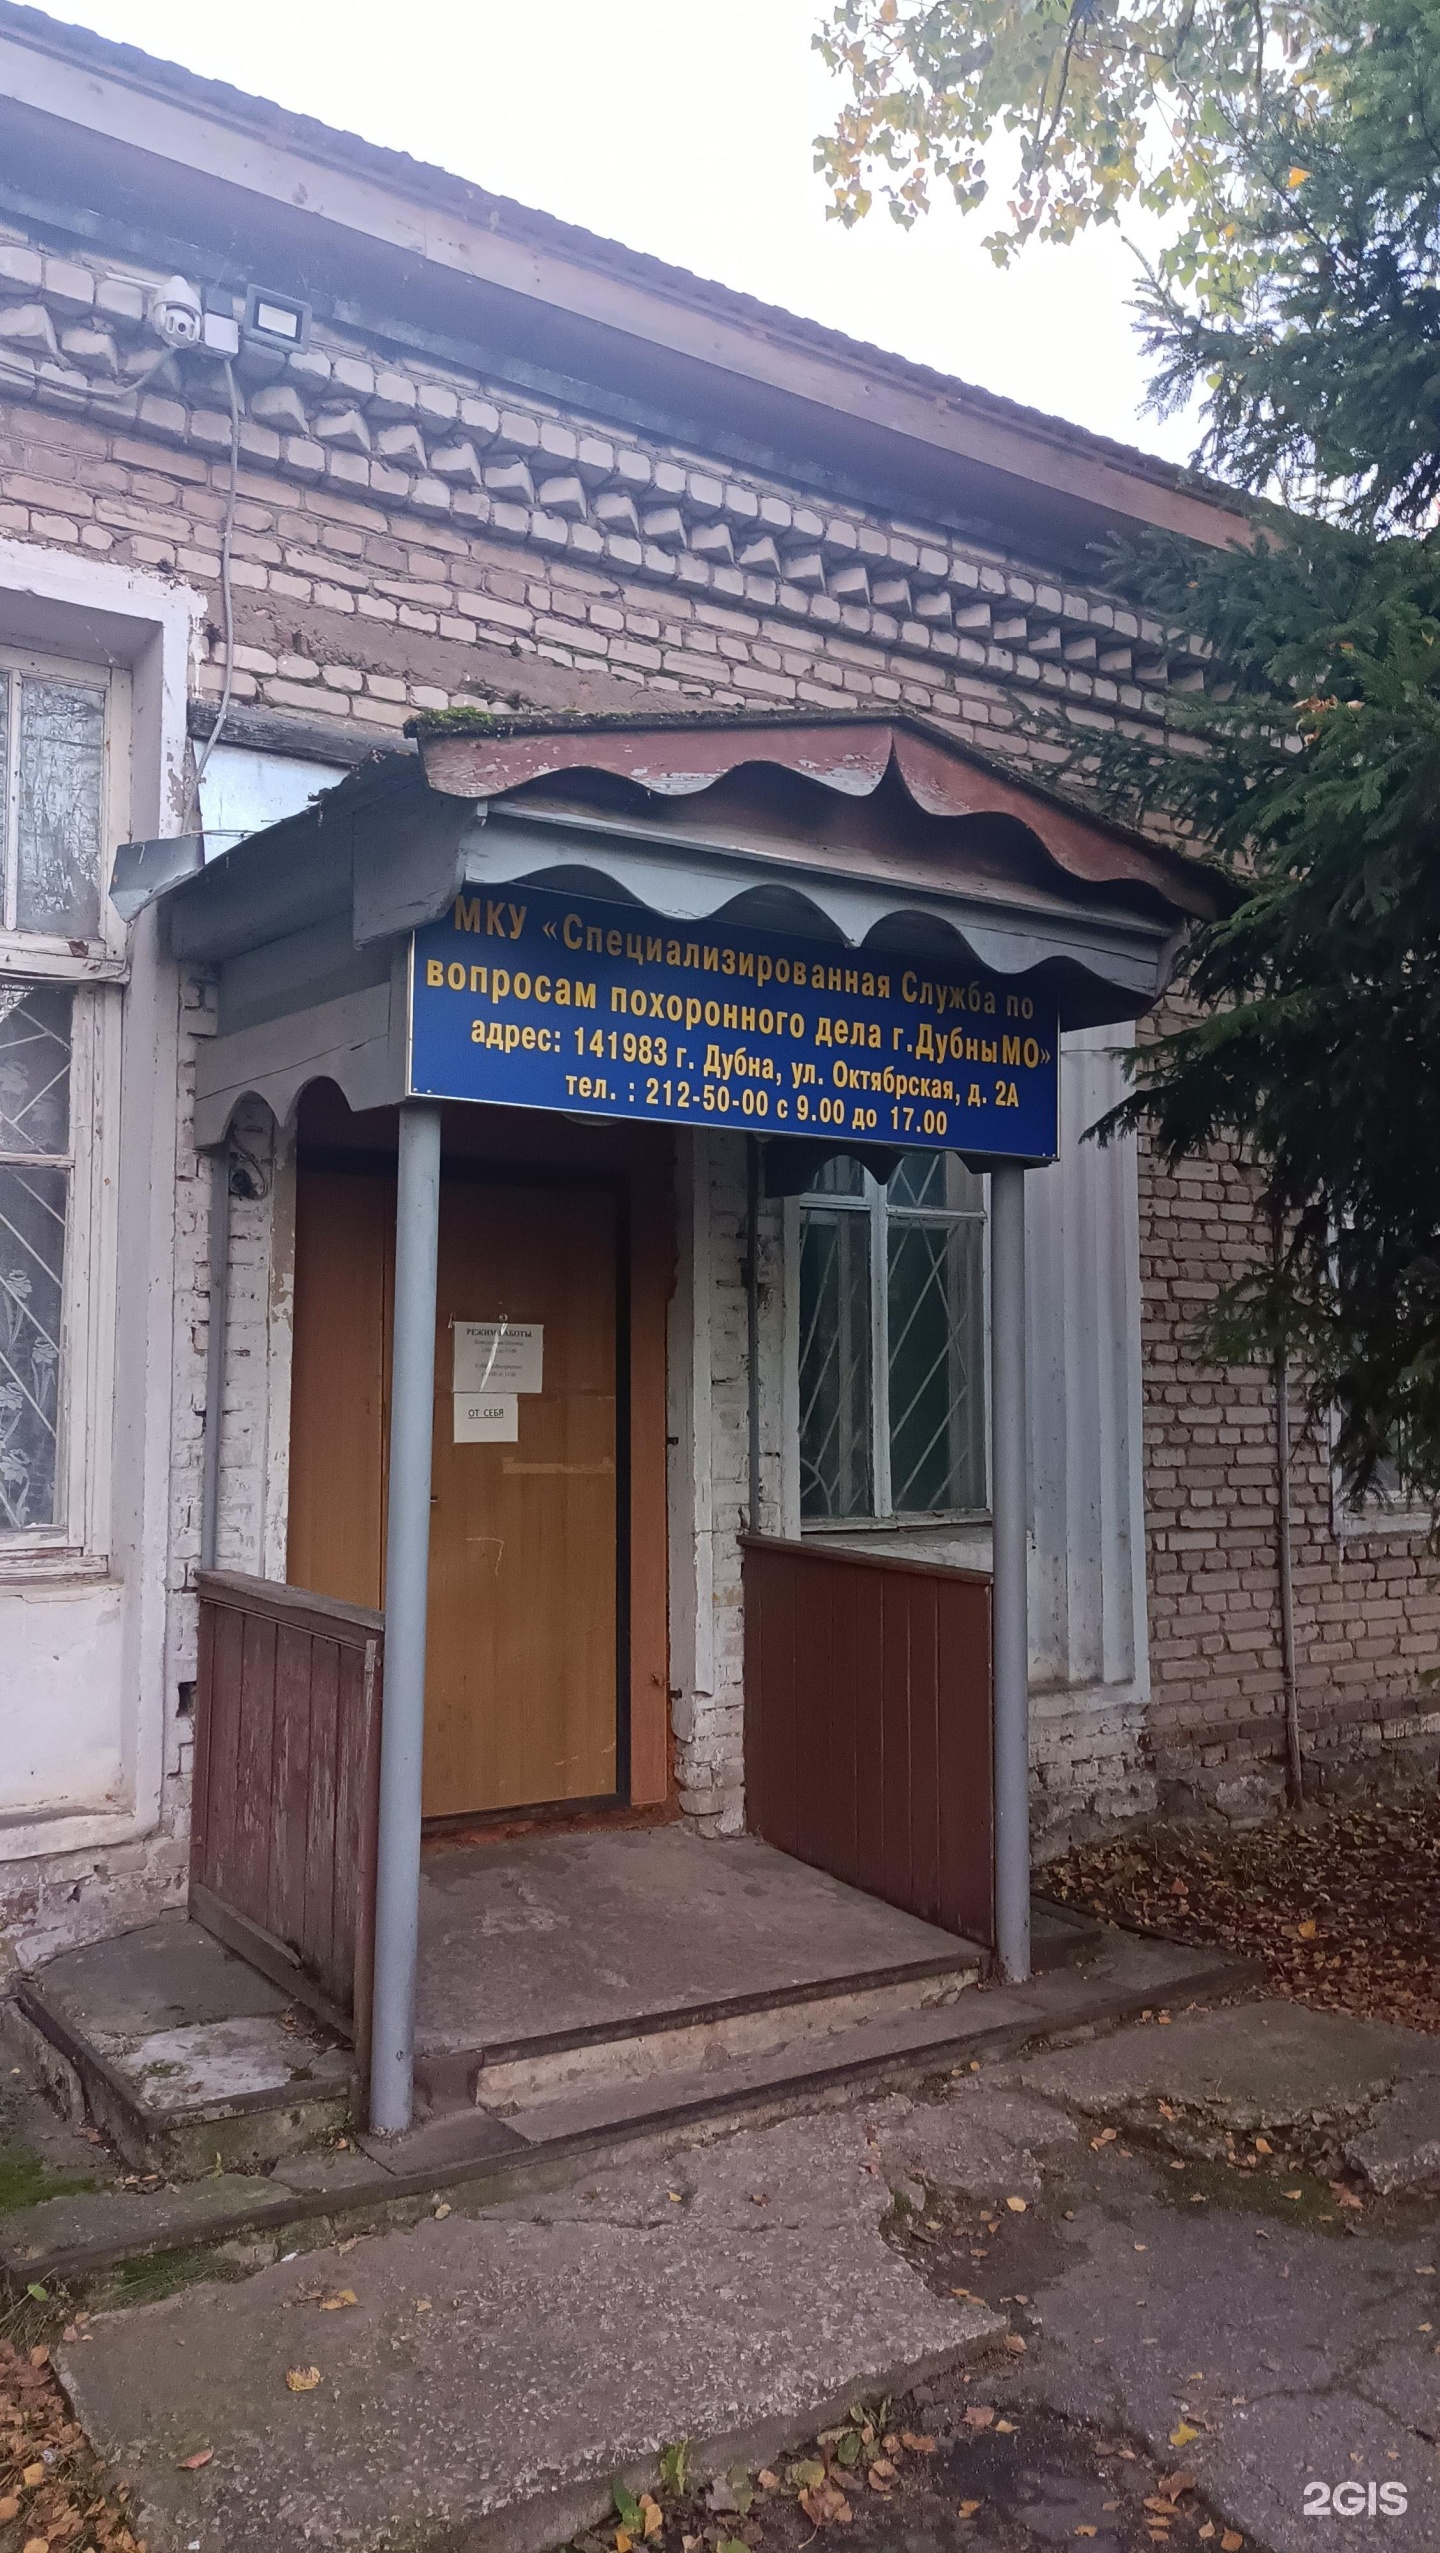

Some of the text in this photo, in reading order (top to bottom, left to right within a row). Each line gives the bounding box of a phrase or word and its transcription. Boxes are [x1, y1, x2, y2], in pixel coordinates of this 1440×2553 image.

[454, 895, 1034, 1020] МКУ «Специализированная Служба по
[427, 959, 596, 1004] вопросам
[611, 986, 805, 1038] похоронного
[815, 1017, 881, 1048] дела
[471, 1019, 561, 1053] адрес:
[574, 1026, 668, 1067] 141983
[676, 1047, 694, 1070] г.
[703, 1044, 782, 1086] Дубна,
[791, 1061, 824, 1089] ул.
[832, 1060, 960, 1106] Октябрская,
[967, 1083, 987, 1107] д.
[646, 1077, 768, 1116] 212-50-00
[777, 1099, 788, 1118] с
[797, 1095, 845, 1124] 9.00
[852, 1107, 877, 1130] до
[891, 1106, 947, 1135] 17.00
[468, 1408, 504, 1418] ОТ СЕБЯ
